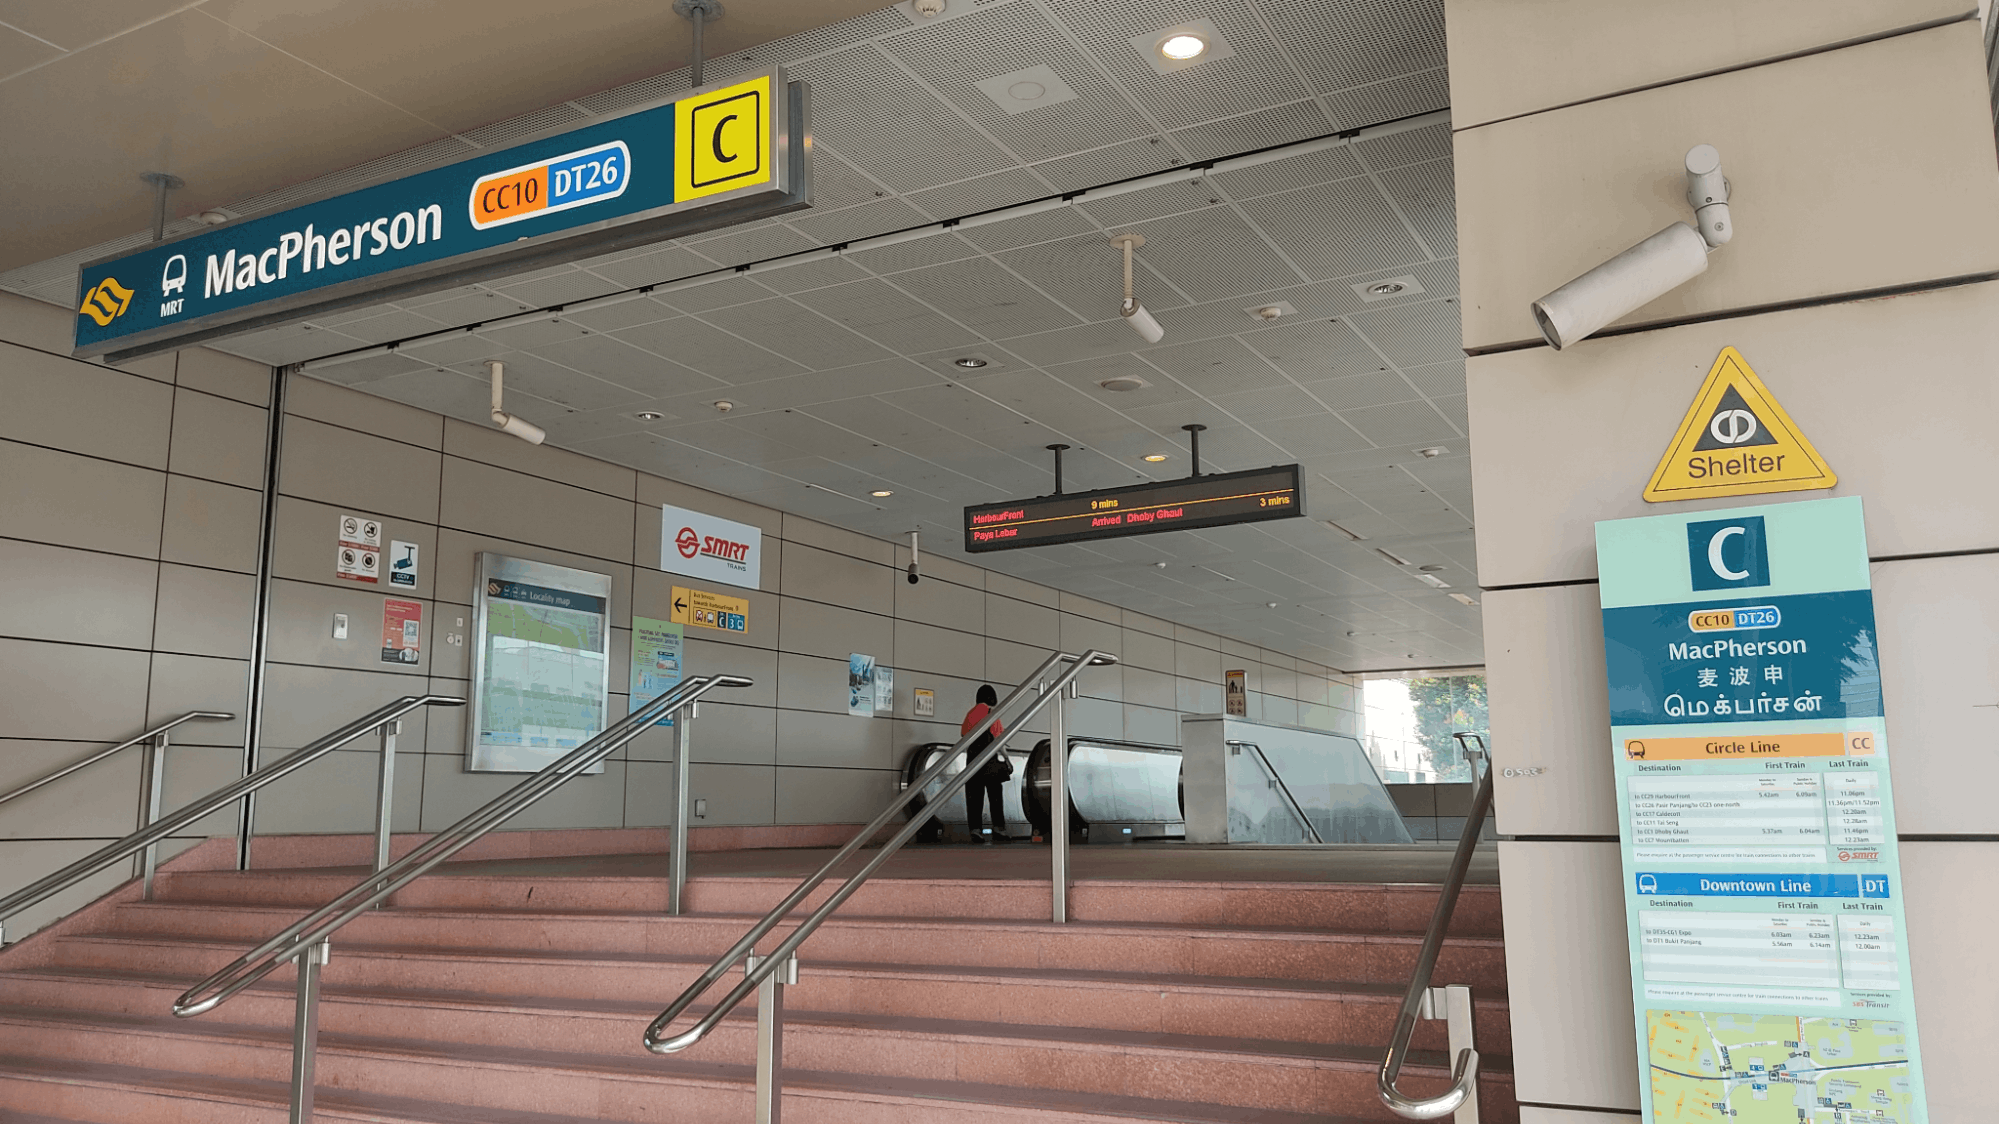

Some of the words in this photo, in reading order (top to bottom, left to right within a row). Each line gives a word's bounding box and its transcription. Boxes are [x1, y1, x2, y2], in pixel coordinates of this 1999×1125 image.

[712, 114, 738, 163] C
[482, 178, 538, 213] CC10
[555, 156, 618, 198] DT26
[204, 203, 442, 299] MacPherson
[160, 299, 184, 317] MRT
[1687, 453, 1785, 479] Shelter
[1091, 500, 1098, 510] 9
[1099, 499, 1118, 509] mins
[1260, 498, 1266, 507] 3
[1268, 496, 1290, 506] mins
[973, 509, 1024, 524] HarbourFront
[1092, 515, 1121, 527] Arrived
[1126, 512, 1155, 523] Dhoby
[1156, 508, 1183, 519] Ghaut
[974, 531, 993, 541] Paya
[701, 536, 750, 561] SMRT
[1708, 526, 1750, 580] C
[727, 562, 746, 572] TRAINS
[530, 591, 554, 604] Locality
[555, 597, 570, 607] map
[718, 616, 724, 627] C
[730, 618, 734, 629] 3
[1696, 614, 1730, 627] CC10
[1738, 611, 1775, 625] DT26
[1668, 638, 1807, 660] MacPherson
[1697, 664, 1783, 688] 麦波申
[1706, 742, 1745, 754] Circle
[1750, 740, 1780, 753] Line
[1852, 738, 1870, 750] CC
[1638, 764, 1682, 772] Destination
[1829, 760, 1844, 768] Last
[1700, 878, 1776, 892] Downtown
[1780, 878, 1812, 892] Line
[1865, 880, 1886, 892] DT
[1650, 900, 1694, 908] Destination
[1842, 902, 1858, 910] Last
[1861, 902, 1883, 910] Train
[1866, 1000, 1890, 1008] Transit
[1780, 1077, 1816, 1086] MacPherson
